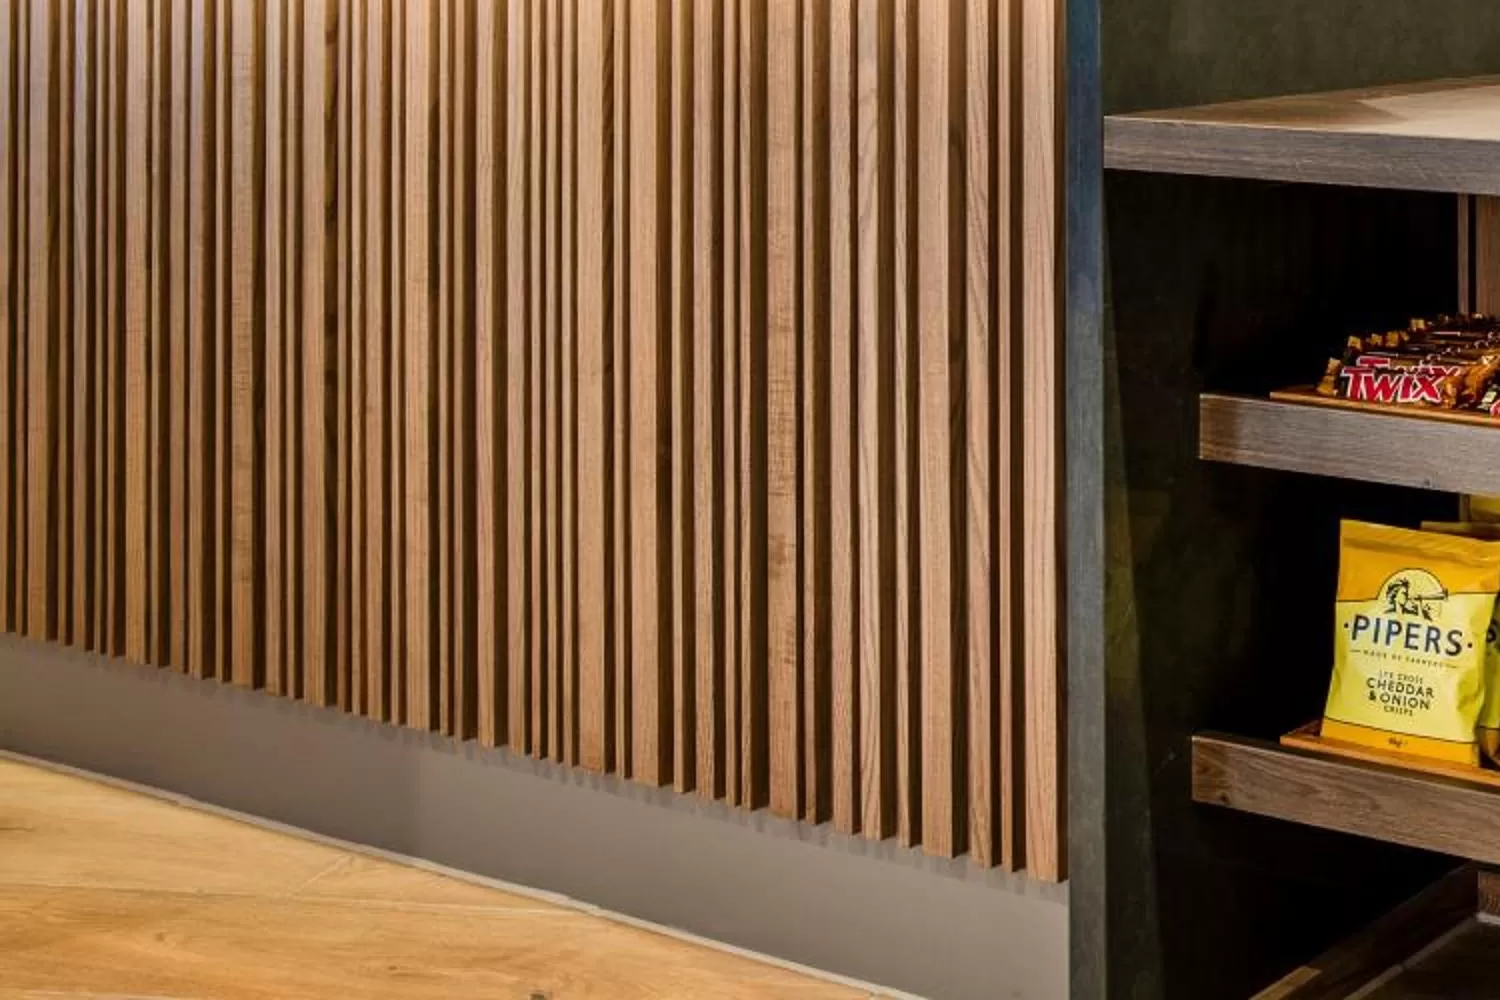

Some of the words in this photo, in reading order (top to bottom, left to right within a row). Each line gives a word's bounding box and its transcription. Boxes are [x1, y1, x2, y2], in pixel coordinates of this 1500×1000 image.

[1351, 614, 1463, 657] PIPERS
[1366, 677, 1435, 699] CHEDDAR
[1368, 690, 1377, 702] &
[1379, 690, 1431, 711] ONION
